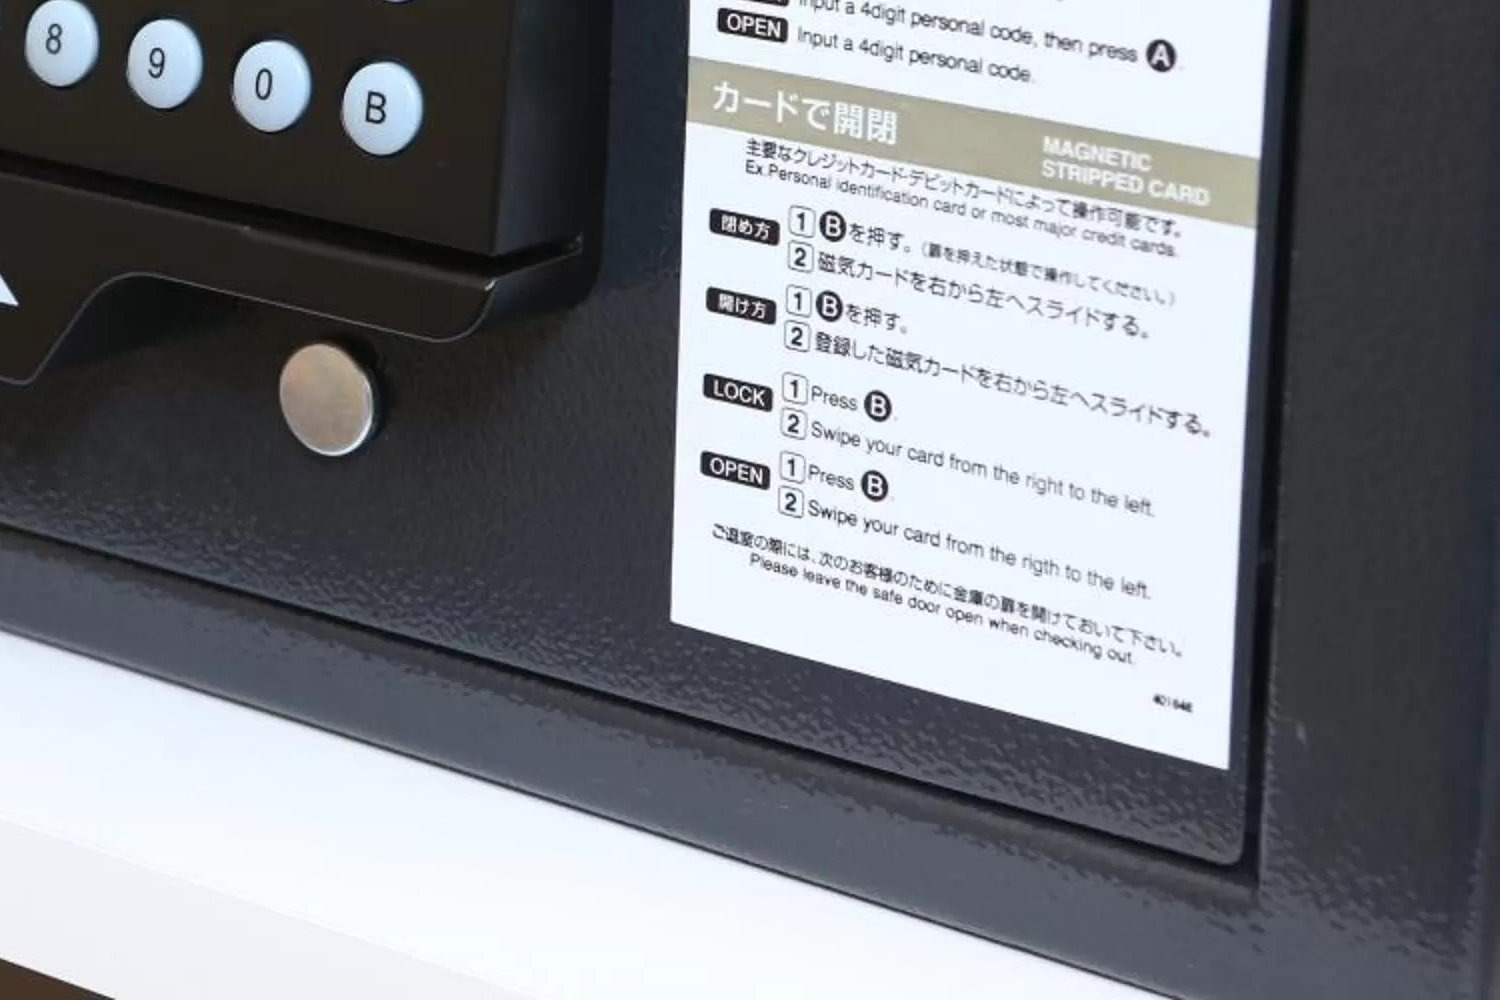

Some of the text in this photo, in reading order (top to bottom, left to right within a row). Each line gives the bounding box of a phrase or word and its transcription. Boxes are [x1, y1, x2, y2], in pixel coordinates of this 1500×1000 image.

[45, 22, 64, 56] 8
[726, 13, 781, 39] OPEN
[845, 1, 855, 15] a
[860, 2, 906, 26] 4digit
[910, 11, 985, 37] personal
[1044, 31, 1083, 53] then
[1088, 41, 1138, 63] press
[147, 47, 166, 80] 9
[797, 26, 839, 50] Input
[843, 38, 854, 52] a
[859, 38, 904, 63] 4digit
[909, 49, 983, 74] personal
[364, 89, 387, 126] B
[712, 80, 898, 145] カードで開閉
[1042, 136, 1153, 172] MAGNETIC
[1041, 160, 1211, 207] STRIPPED CARD
[720, 214, 771, 241] 閉め方
[824, 212, 843, 239] B
[836, 178, 929, 209] identification
[933, 200, 966, 216] card
[971, 207, 988, 220] or
[991, 210, 1029, 229] most
[1033, 218, 1076, 239] major
[1082, 228, 1126, 248] credit
[717, 292, 768, 320] 開け方
[820, 293, 840, 319] B
[712, 379, 766, 407] LOCK
[811, 385, 858, 411] Press
[708, 457, 765, 485] OPEN
[808, 464, 855, 491] Press
[811, 421, 861, 447] Swipe
[866, 436, 903, 457] your
[907, 446, 944, 468] card
[949, 452, 988, 478] from
[992, 464, 1021, 485] the
[1025, 472, 1064, 496] right
[1069, 483, 1085, 501] to
[1090, 487, 1119, 509] the
[807, 500, 859, 528] Swipe
[863, 516, 900, 536] your
[903, 525, 941, 548] card
[946, 533, 985, 558] from
[989, 545, 1017, 567] the
[1065, 564, 1082, 583] to
[1087, 568, 1115, 591] the
[750, 552, 799, 578] Please
[803, 568, 841, 589] leave
[845, 578, 869, 597] the
[873, 586, 904, 605] safe
[907, 597, 941, 615] door
[945, 606, 983, 627] open
[989, 617, 1029, 638] when
[1033, 626, 1103, 660] checking
